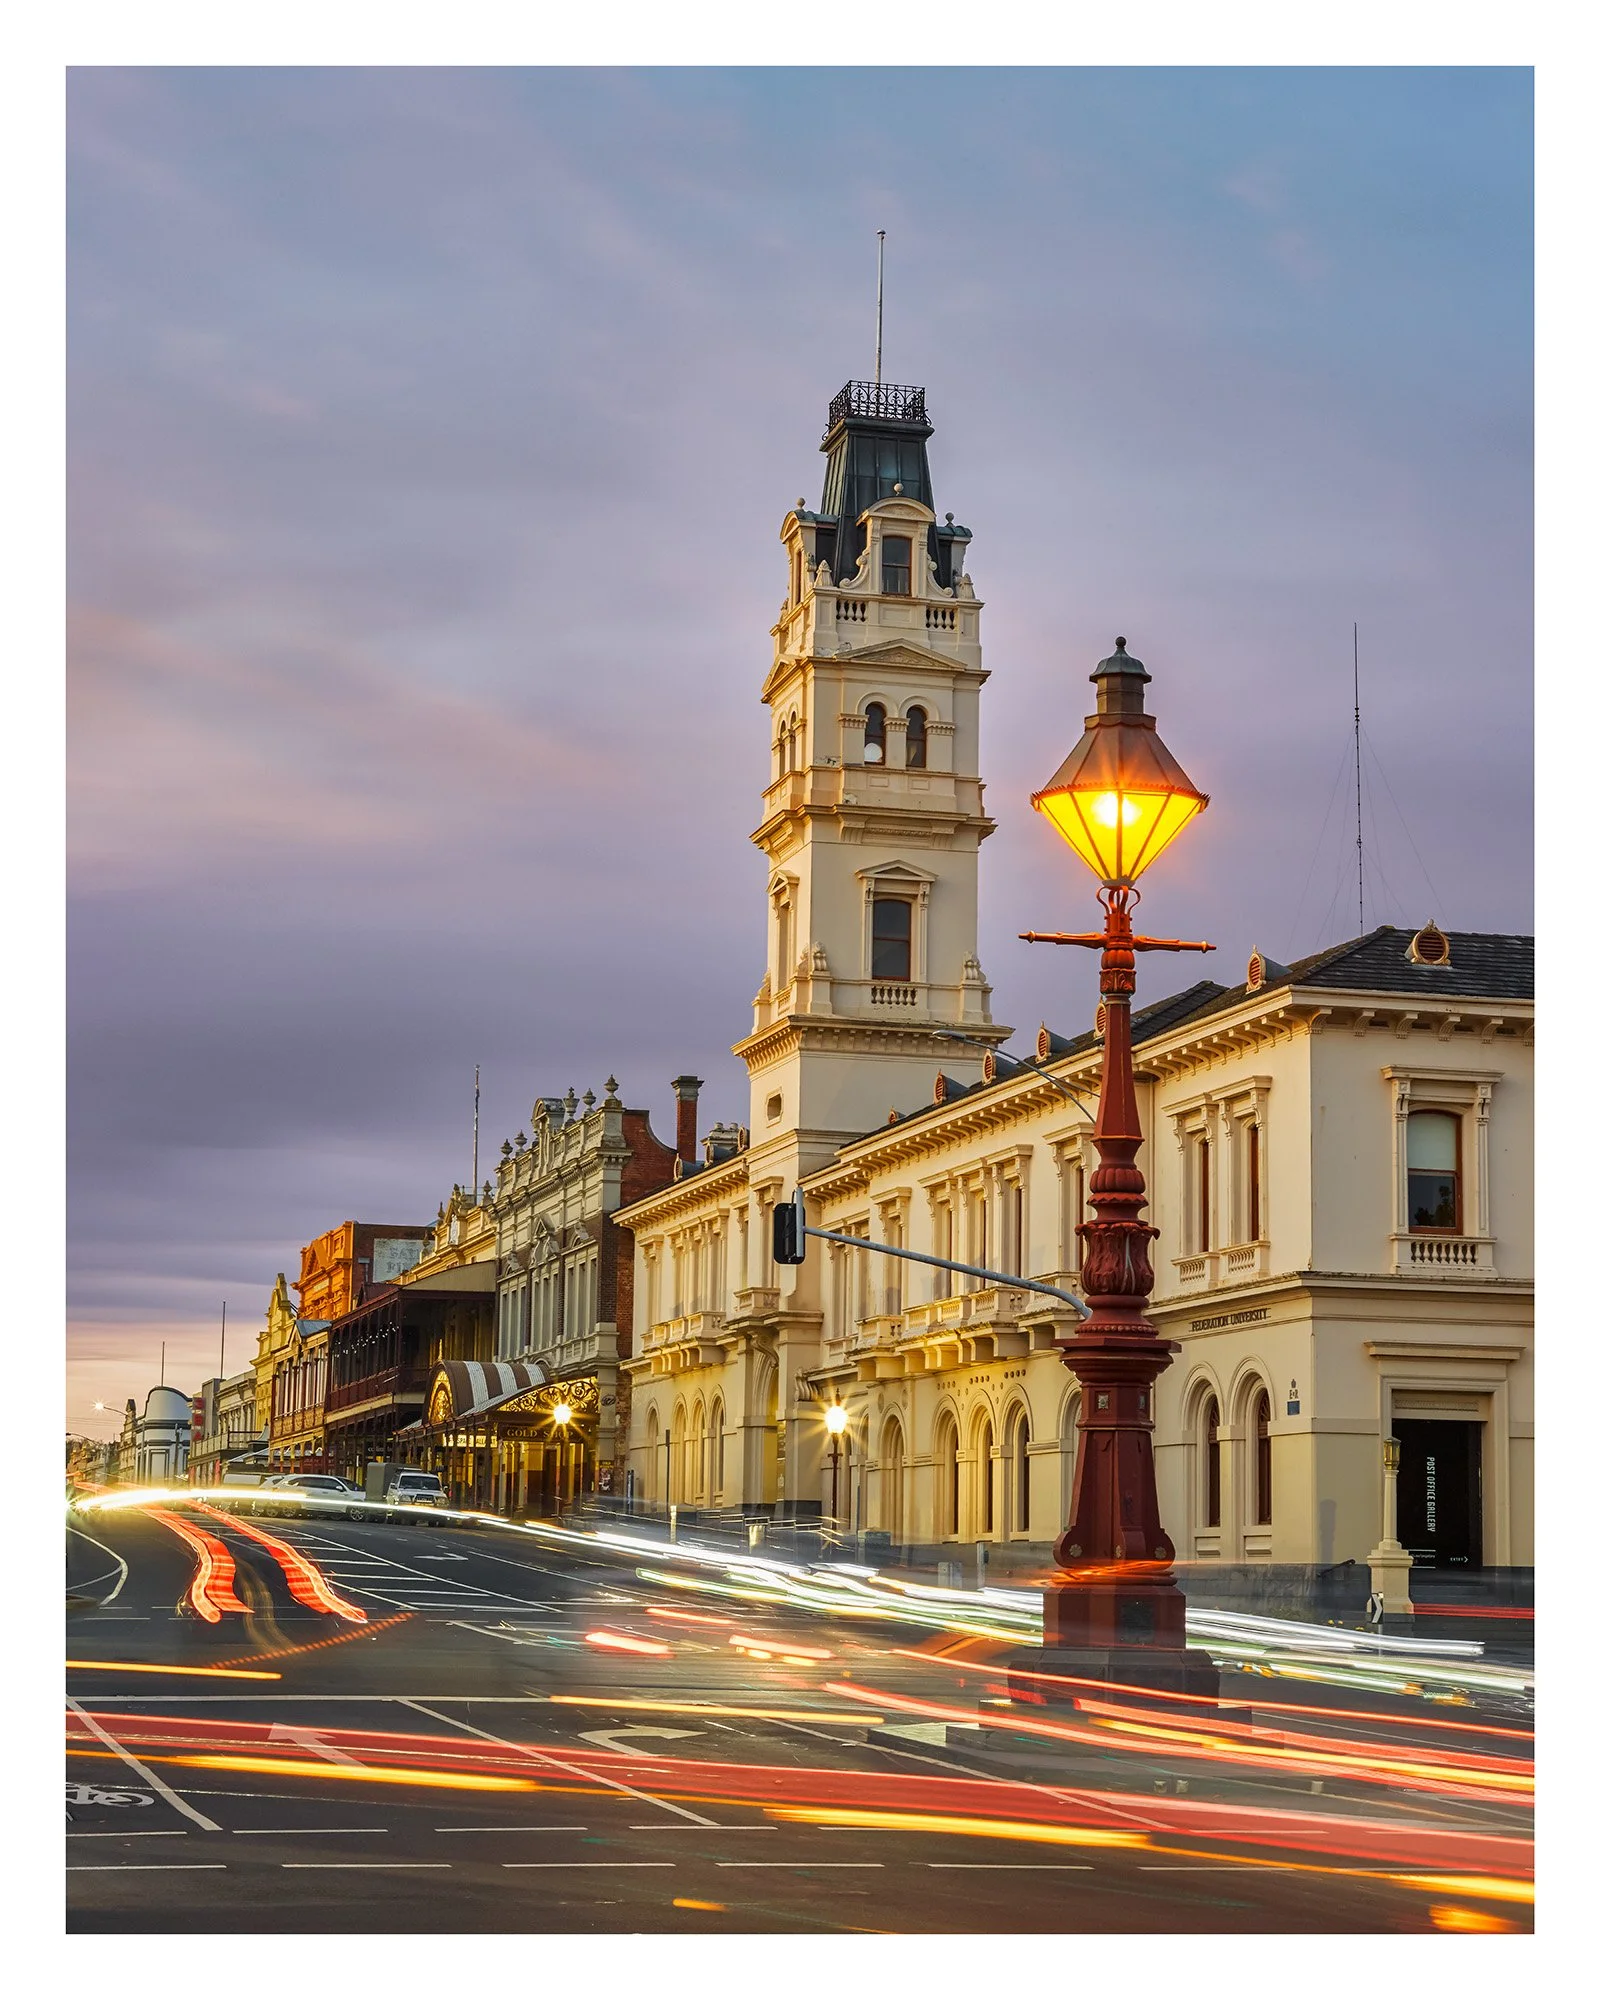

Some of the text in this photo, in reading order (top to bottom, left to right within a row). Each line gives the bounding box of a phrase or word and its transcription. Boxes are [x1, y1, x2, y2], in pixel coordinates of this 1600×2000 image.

[1191, 1308, 1268, 1332] FEDERATION UNIVERSITY
[506, 1429, 538, 1438] GOLD
[1426, 1456, 1436, 1533] POST OFFICE GALLERY
